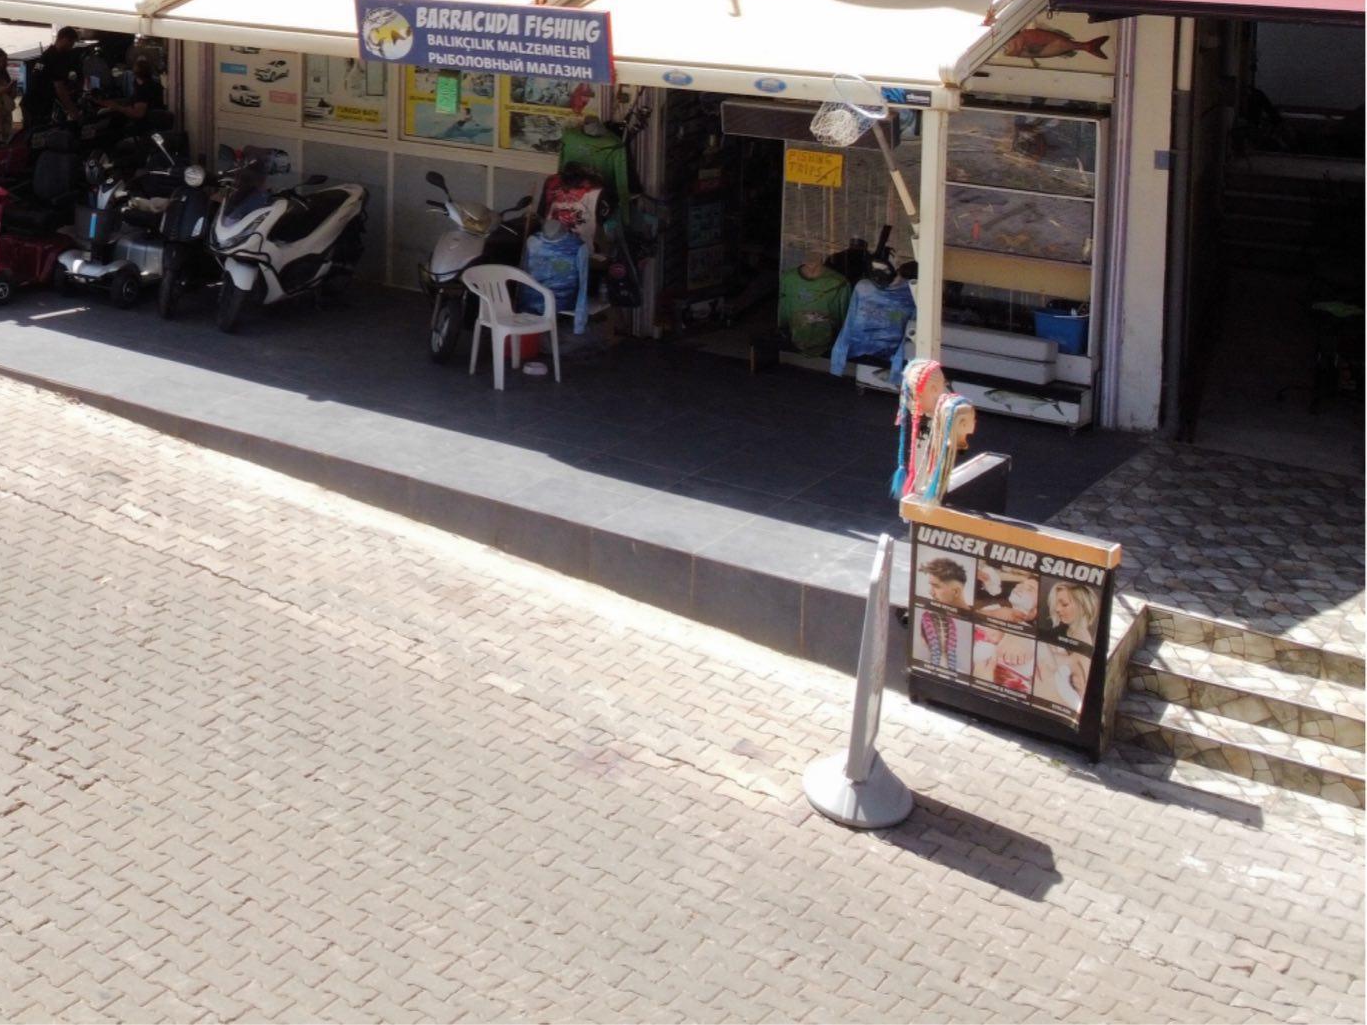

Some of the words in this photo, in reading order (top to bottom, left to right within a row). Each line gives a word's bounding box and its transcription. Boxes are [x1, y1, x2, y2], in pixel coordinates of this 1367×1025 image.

[415, 6, 520, 36] BARRACUDA
[524, 15, 602, 44] FISHING
[427, 34, 495, 52] BALIKÇILIK
[497, 40, 591, 60] MALZEMELERİ
[428, 53, 524, 73] РЫБОЛОВНЫЙ
[526, 63, 593, 79] МАГАЗИН
[917, 526, 988, 557] UNISEX
[990, 542, 1035, 569] HAIR
[1039, 557, 1106, 586] SALON
